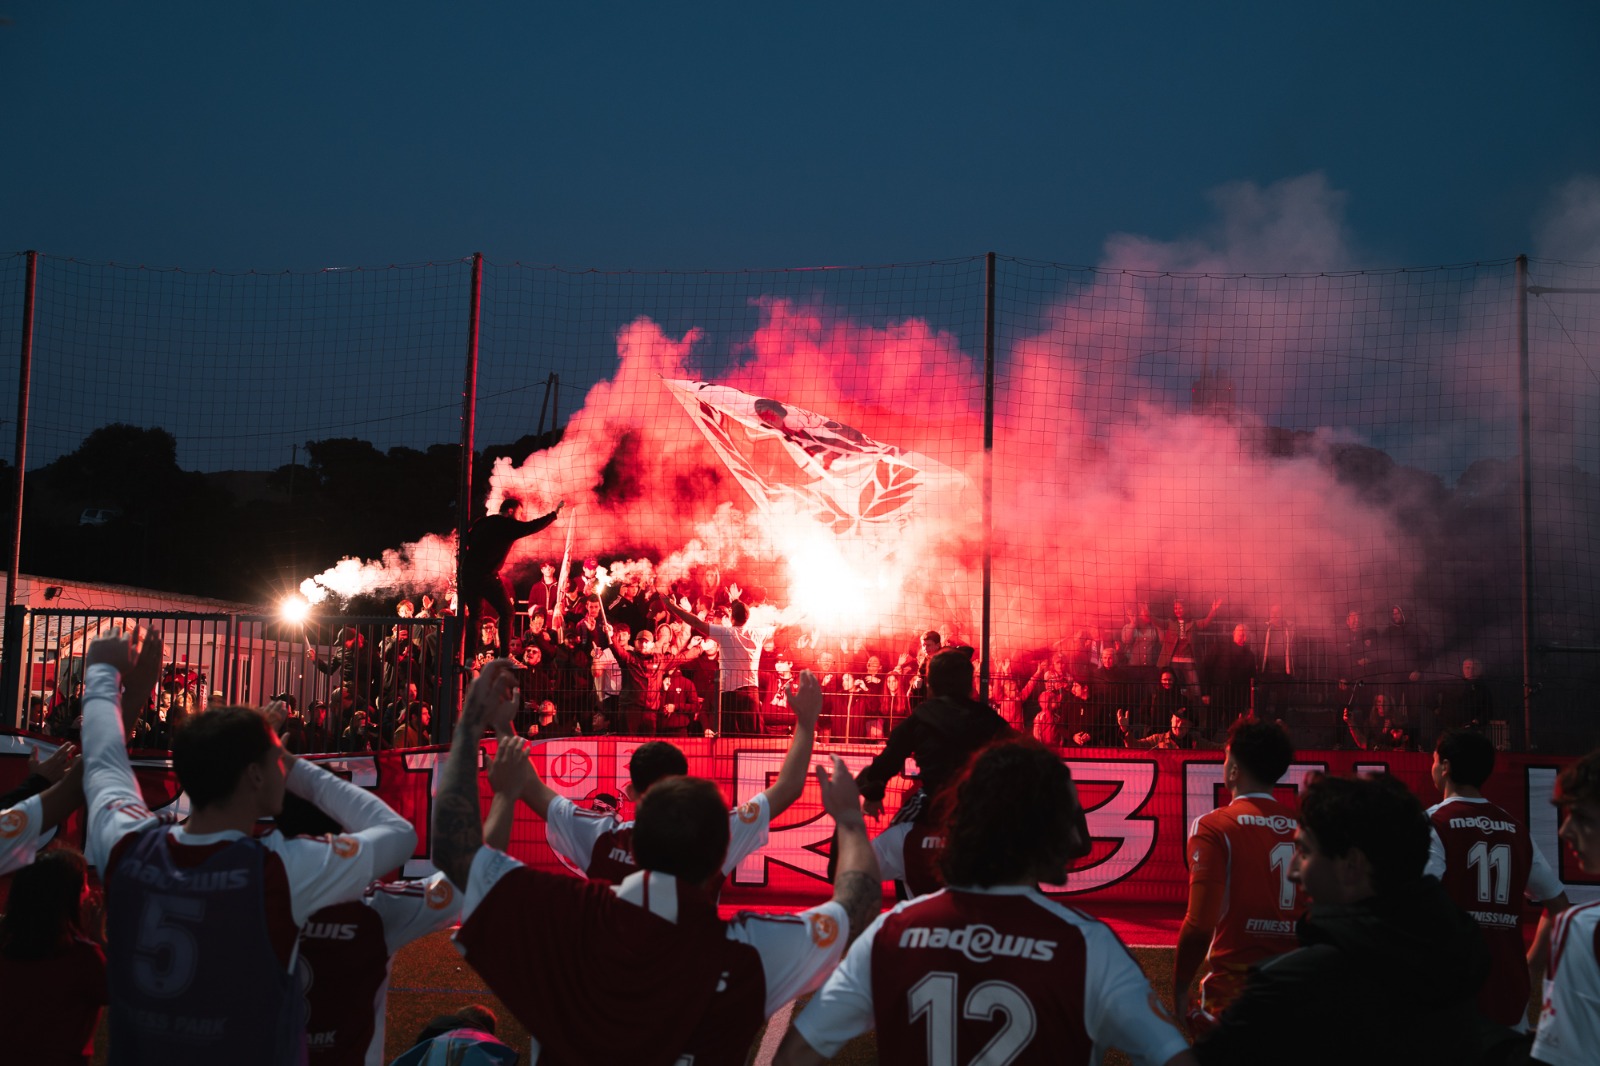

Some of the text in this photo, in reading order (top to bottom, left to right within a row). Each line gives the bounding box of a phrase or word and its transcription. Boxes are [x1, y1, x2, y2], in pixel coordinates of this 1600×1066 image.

[1467, 841, 1511, 905] 11
[132, 891, 207, 999] 5
[1245, 918, 1290, 933] FITNESS
[175, 1015, 228, 1035] PARK
[907, 970, 1037, 1066] 12
